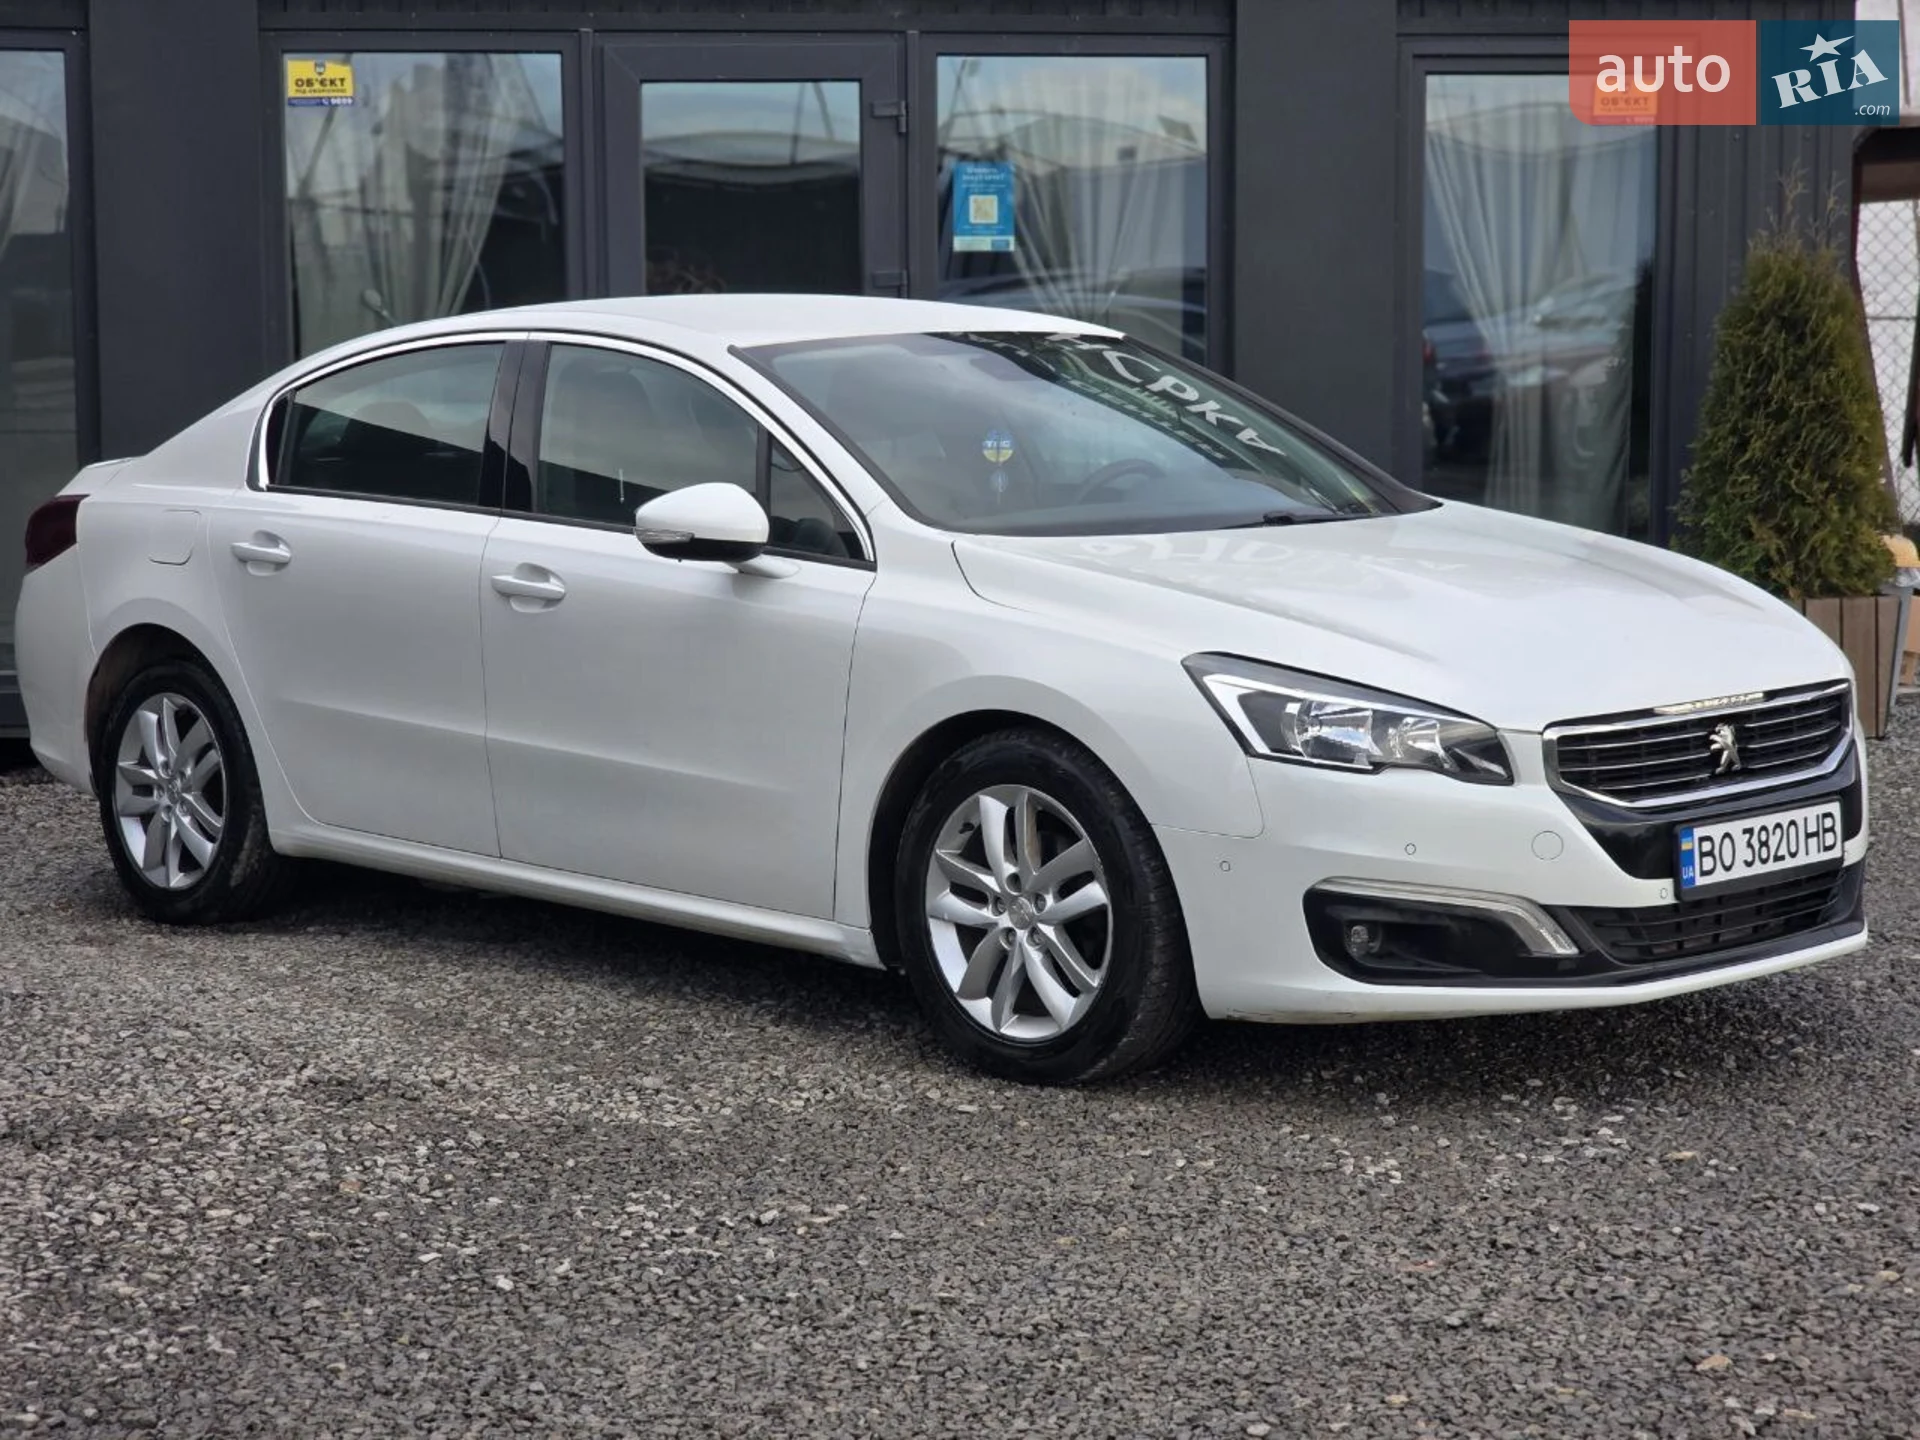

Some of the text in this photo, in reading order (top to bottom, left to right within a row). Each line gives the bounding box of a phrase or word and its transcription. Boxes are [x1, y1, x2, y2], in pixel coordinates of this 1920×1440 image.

[1697, 811, 1838, 877] BO 3820 HB
[1682, 867, 1694, 879] UA
